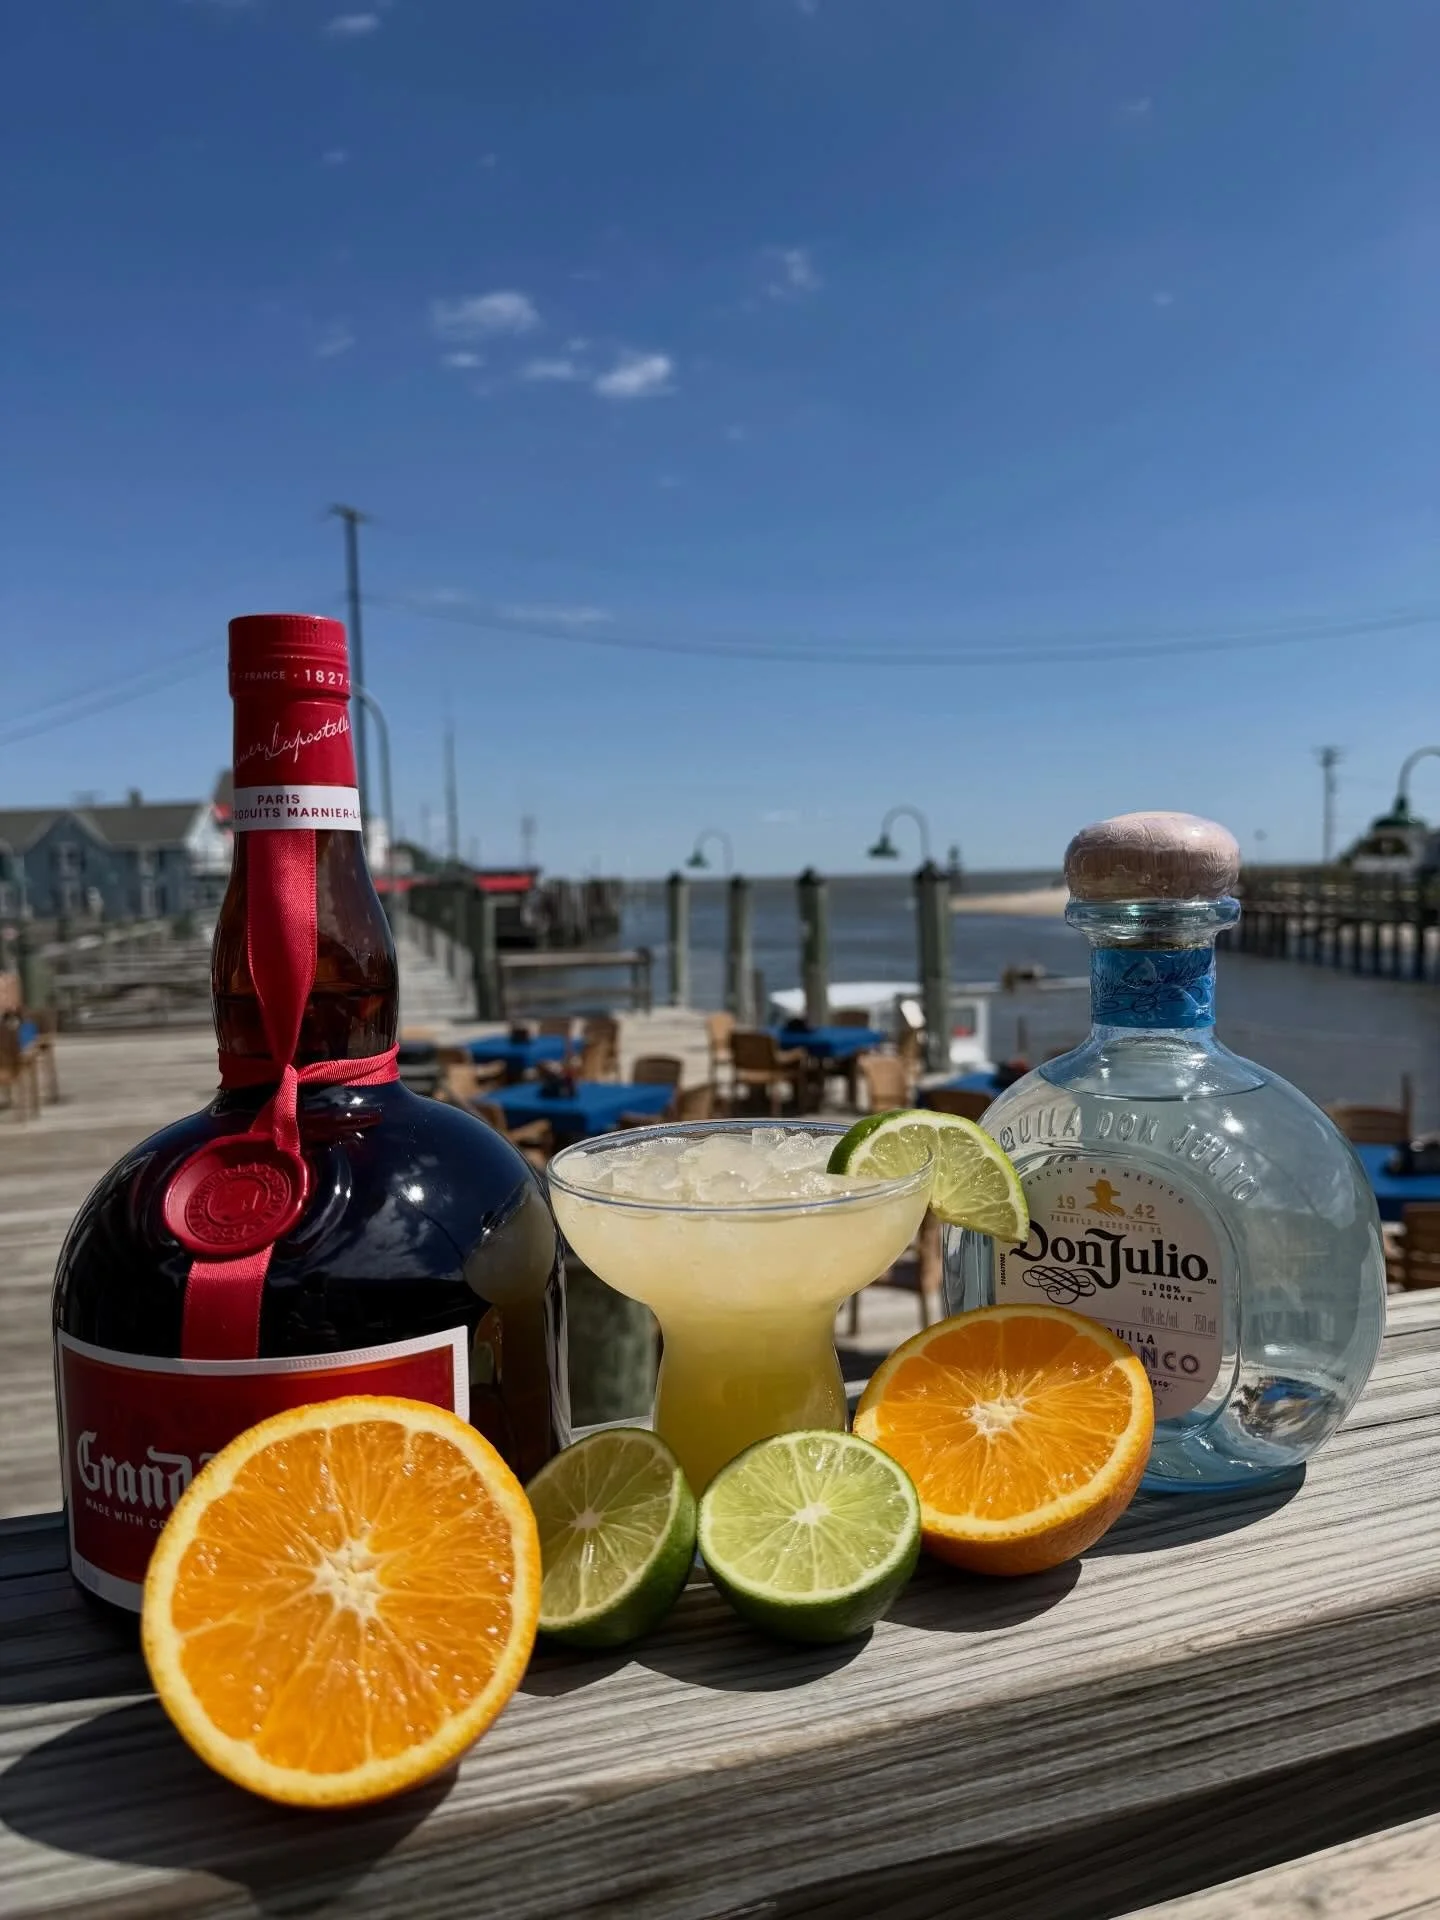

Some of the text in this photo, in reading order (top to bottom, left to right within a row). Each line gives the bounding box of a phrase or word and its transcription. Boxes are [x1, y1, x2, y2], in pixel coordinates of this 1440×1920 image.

[304, 669, 344, 686] 1827
[257, 794, 300, 805] PARIS
[1097, 1111, 1161, 1144] DON
[1171, 1124, 1259, 1201] JULIO
[1089, 1166, 1107, 1175] EN
[1055, 1194, 1156, 1220] 19 42
[1141, 1289, 1193, 1303] DE AGAVE
[1152, 1282, 1181, 1294] 100%
[1125, 1343, 1199, 1375] NCO
[77, 1430, 193, 1511] Grand
[86, 1497, 110, 1517] MADE
[114, 1510, 144, 1527] WITH
